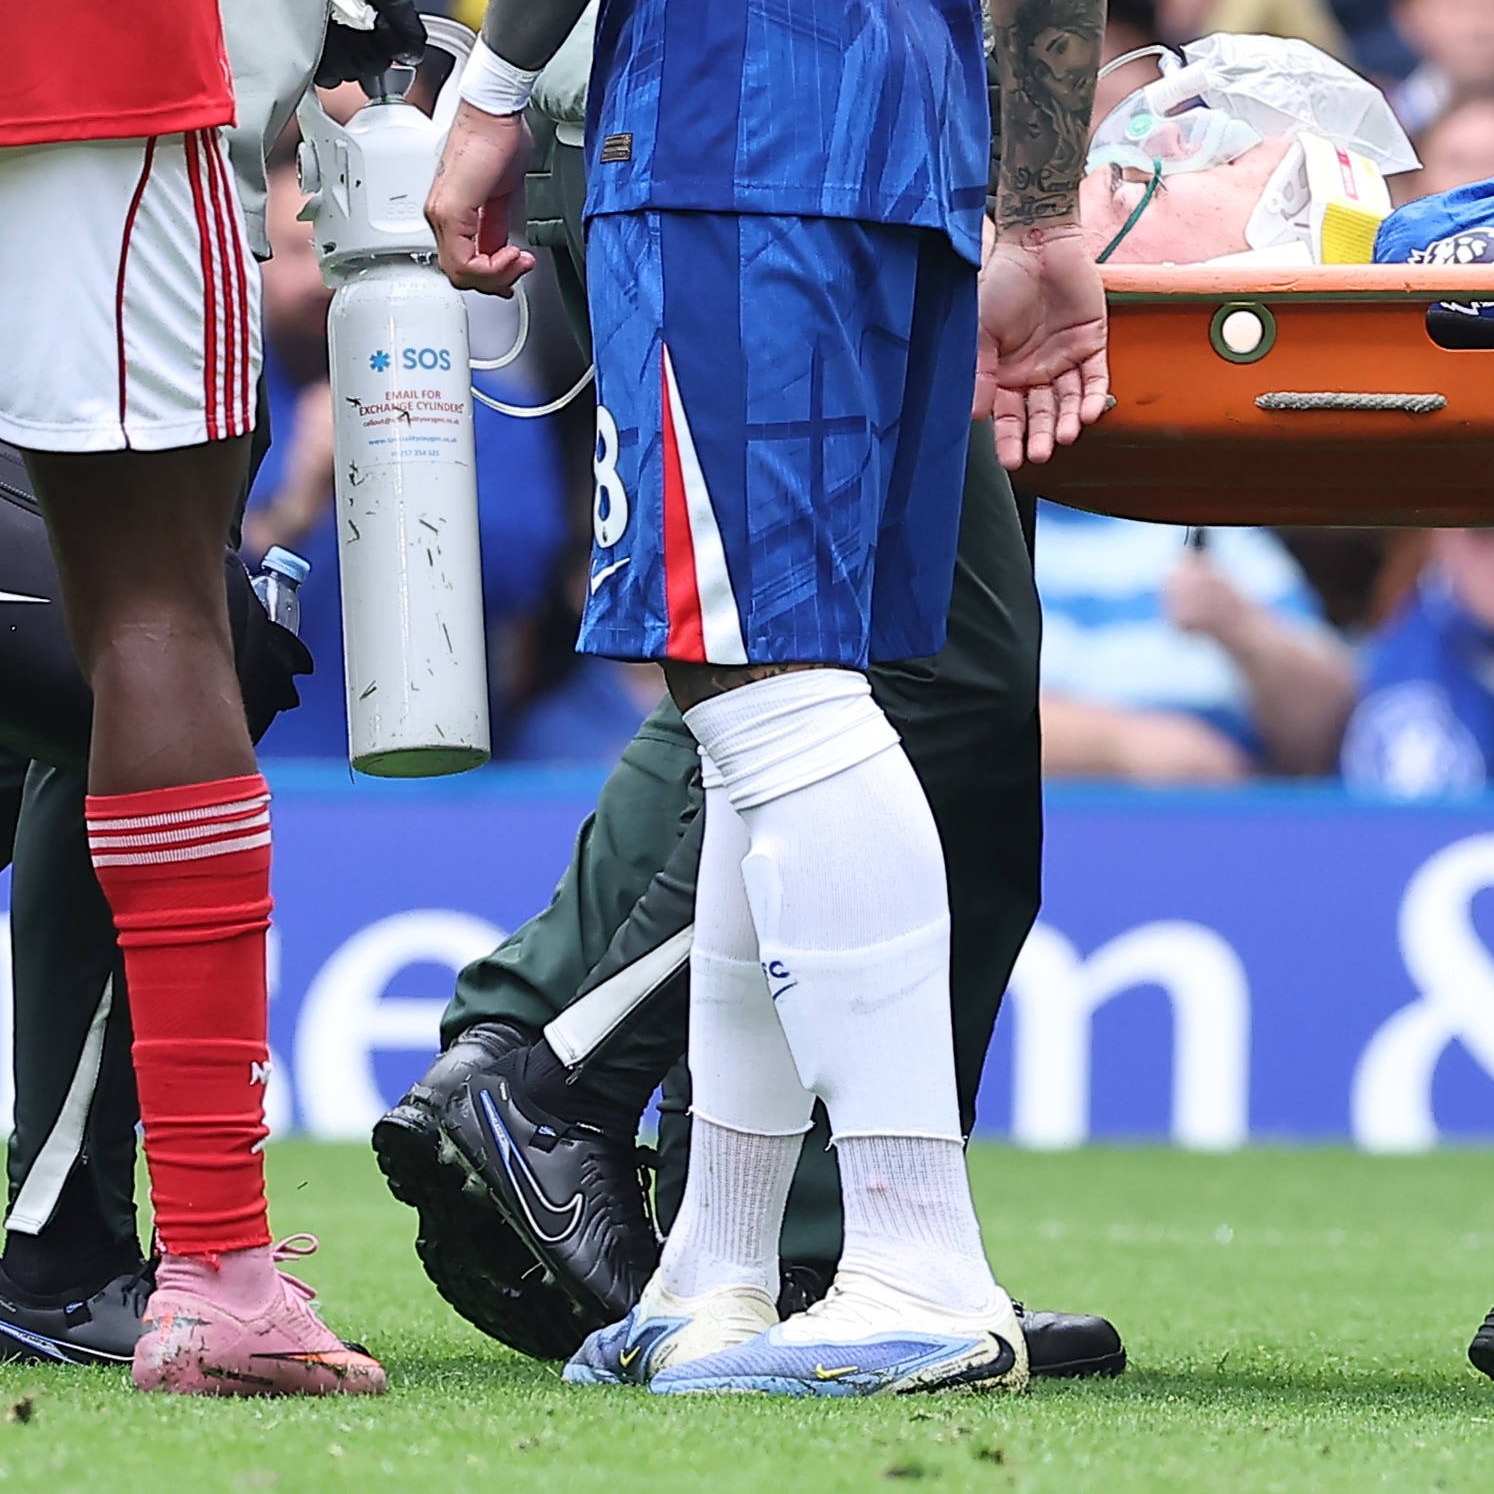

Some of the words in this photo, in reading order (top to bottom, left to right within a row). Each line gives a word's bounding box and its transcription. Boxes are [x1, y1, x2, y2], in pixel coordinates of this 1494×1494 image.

[402, 347, 451, 371] SOS
[385, 390, 418, 401] EMAIL
[421, 389, 441, 400] FOR
[359, 401, 413, 417] EXCHANGE
[416, 401, 464, 414] CYLINDERS
[593, 405, 628, 548] 8
